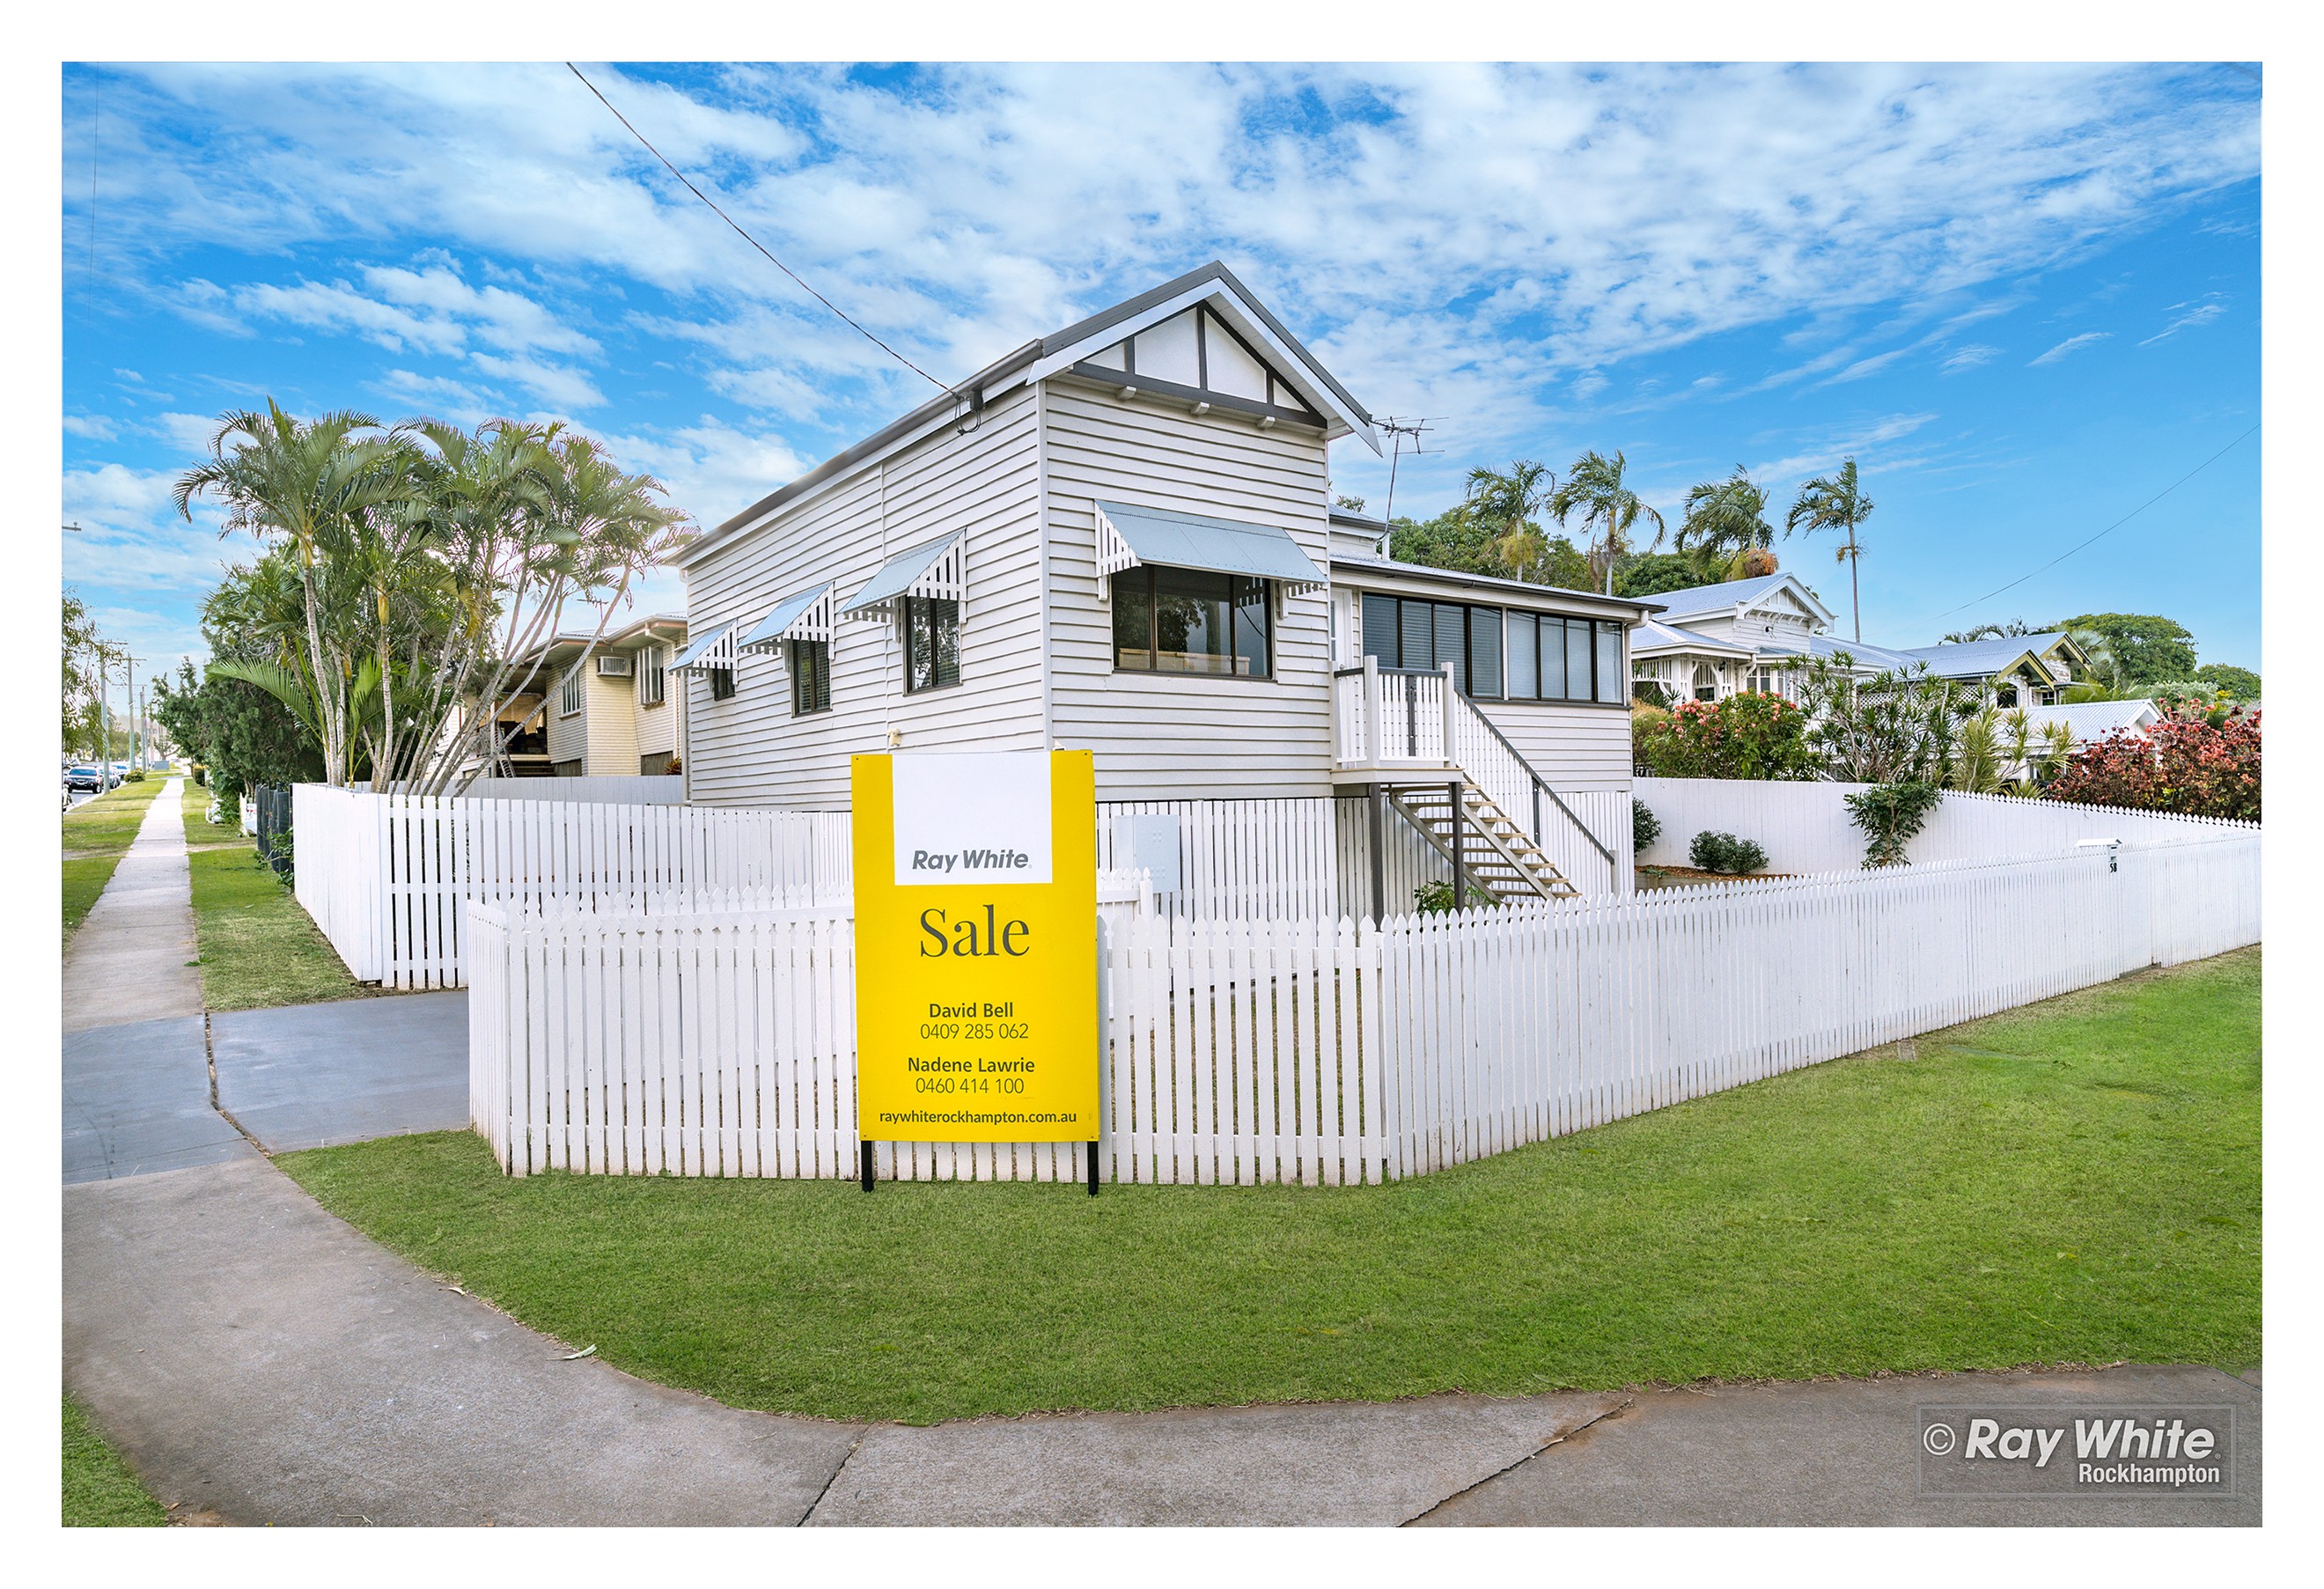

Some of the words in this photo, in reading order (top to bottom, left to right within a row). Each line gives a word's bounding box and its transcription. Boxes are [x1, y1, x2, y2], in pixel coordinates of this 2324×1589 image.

[912, 850, 959, 873] Ray
[2109, 862, 2117, 872] 58
[920, 903, 1030, 958] Sale
[929, 1002, 977, 1018] David
[982, 1002, 1013, 1018] Bell
[920, 1023, 960, 1039] 0409
[964, 1023, 994, 1039] 285
[998, 1023, 1029, 1039] 062
[908, 1056, 973, 1072] Nadene
[978, 1056, 1035, 1072] Lawrie
[916, 1078, 955, 1093] 0460
[960, 1078, 989, 1093] 414
[996, 1078, 1025, 1093] 100
[879, 1110, 1077, 1125] raywhiterockhampton.com.au
